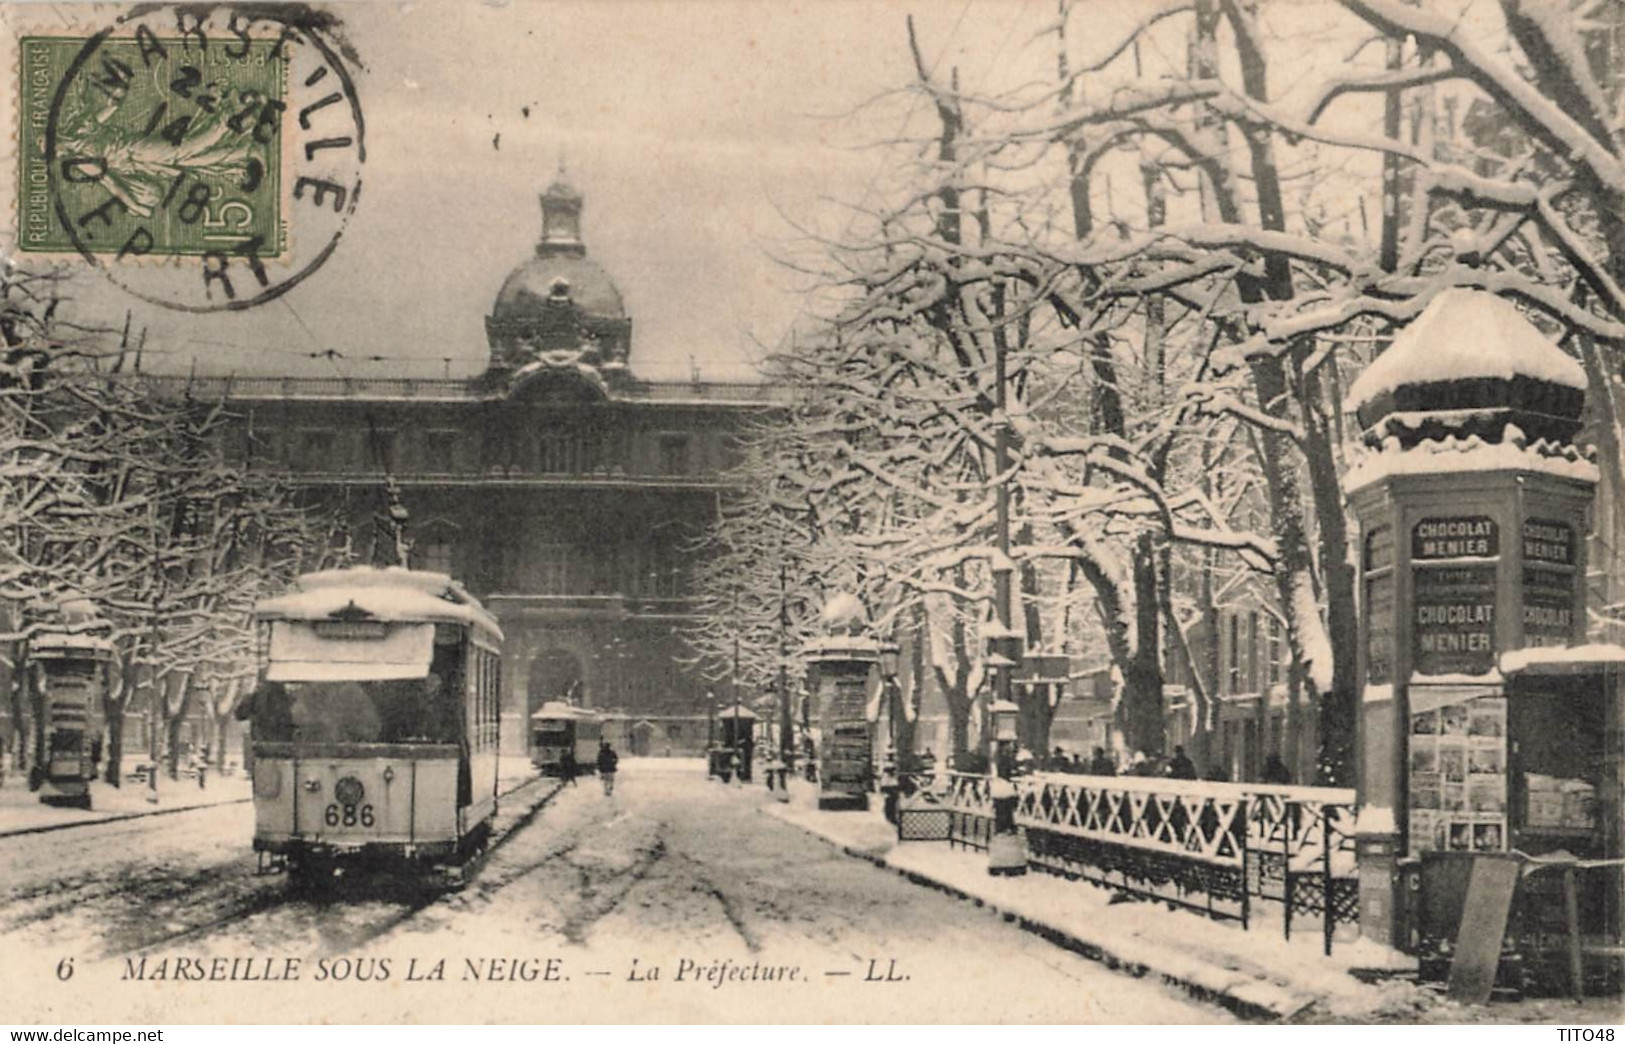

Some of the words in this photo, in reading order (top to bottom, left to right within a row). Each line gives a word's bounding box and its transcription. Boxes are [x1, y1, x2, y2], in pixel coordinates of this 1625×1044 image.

[1418, 521, 1492, 537] CHOCOLAT
[1423, 540, 1488, 556] MENIER
[1418, 604, 1493, 624] CHOCOLAT
[1421, 633, 1490, 651] MENIER
[325, 804, 375, 828] 686
